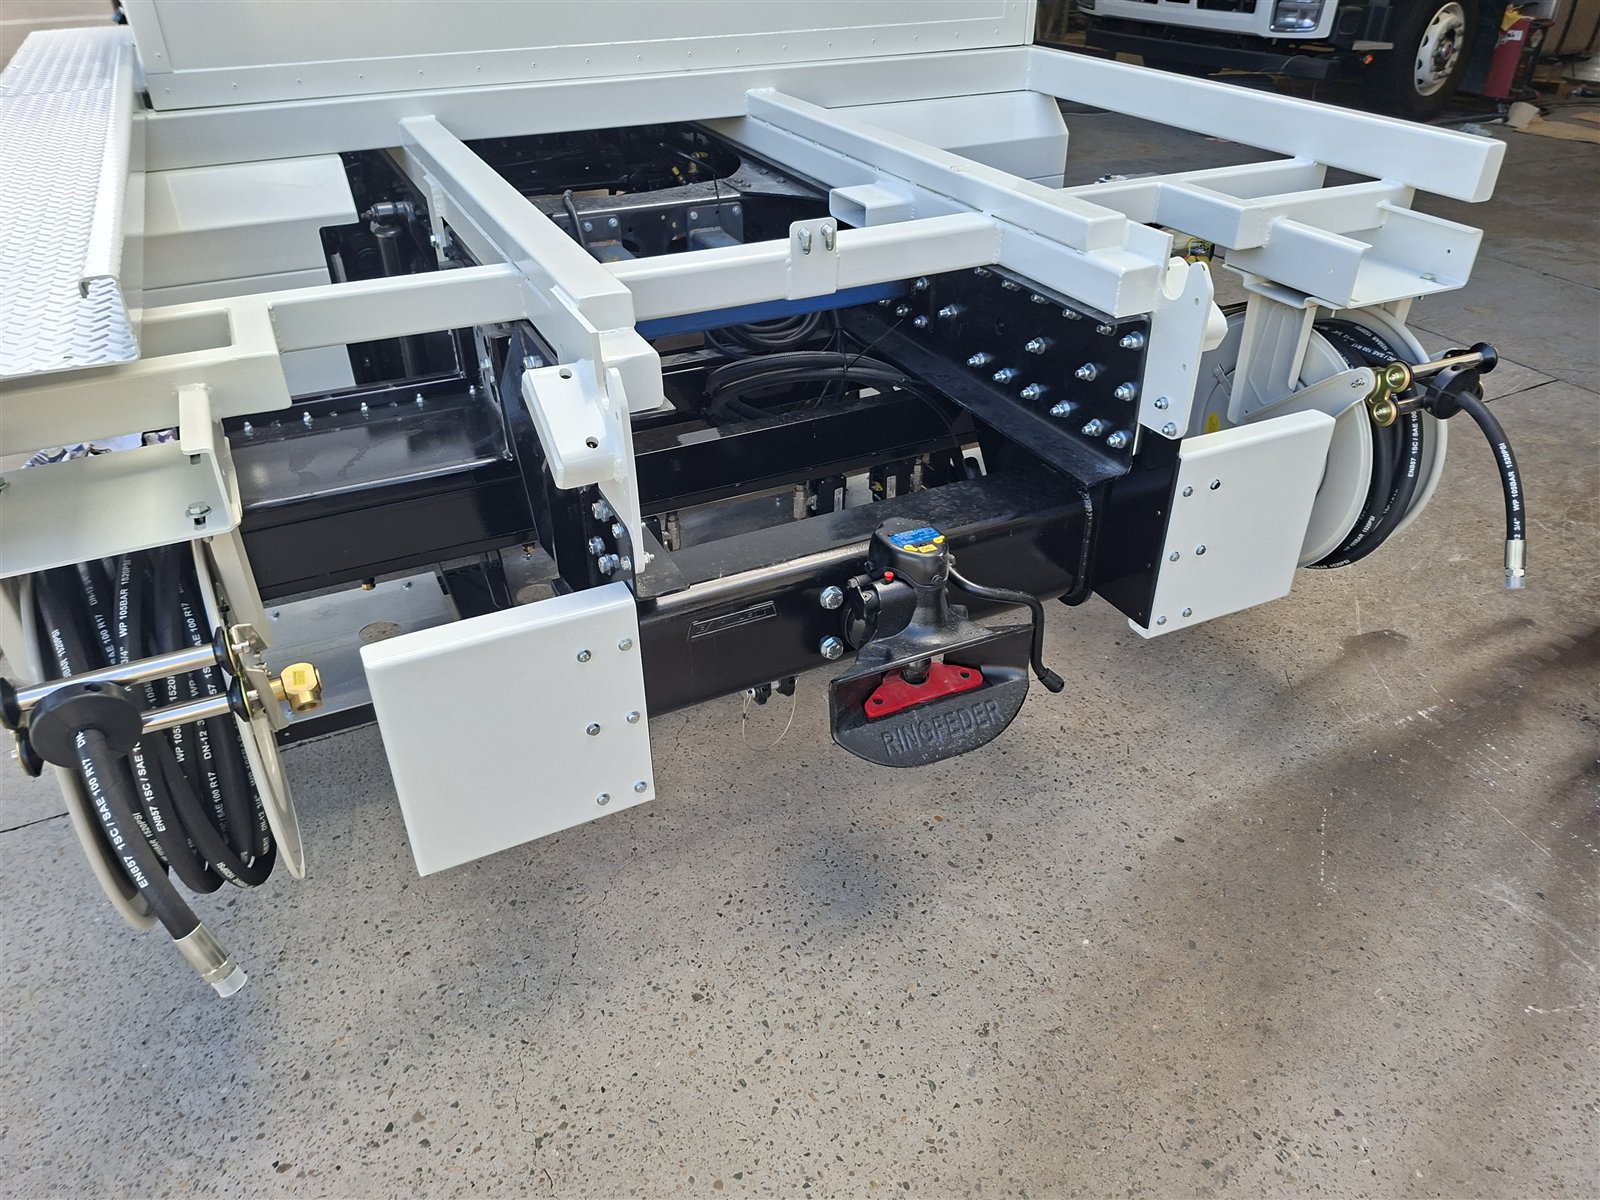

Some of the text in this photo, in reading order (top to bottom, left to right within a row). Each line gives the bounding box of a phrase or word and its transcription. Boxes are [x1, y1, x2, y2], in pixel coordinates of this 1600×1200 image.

[1498, 442, 1513, 469] 1520PSI
[1508, 470, 1519, 498] 105BAR
[1512, 499, 1520, 512] WP
[119, 588, 129, 620] 105BAR
[180, 602, 193, 617] R17
[94, 614, 107, 629] R17
[118, 622, 128, 638] WP
[187, 618, 197, 632] 100
[51, 628, 67, 657] 1520PSI
[100, 629, 112, 644] 100
[192, 634, 202, 647] AE
[188, 680, 199, 697] WP
[881, 699, 1005, 757] RINGFEDER
[175, 746, 185, 763] WP
[199, 730, 212, 760] DN-12
[81, 758, 95, 777] R17
[134, 754, 147, 777] SAE
[87, 777, 101, 796] 100
[207, 771, 219, 789] R17
[141, 783, 155, 802] 1SC
[211, 789, 222, 803] 100
[95, 796, 112, 822] SAE
[148, 805, 167, 833] EN857
[109, 827, 126, 850] 1SC
[123, 855, 149, 889] EN857
